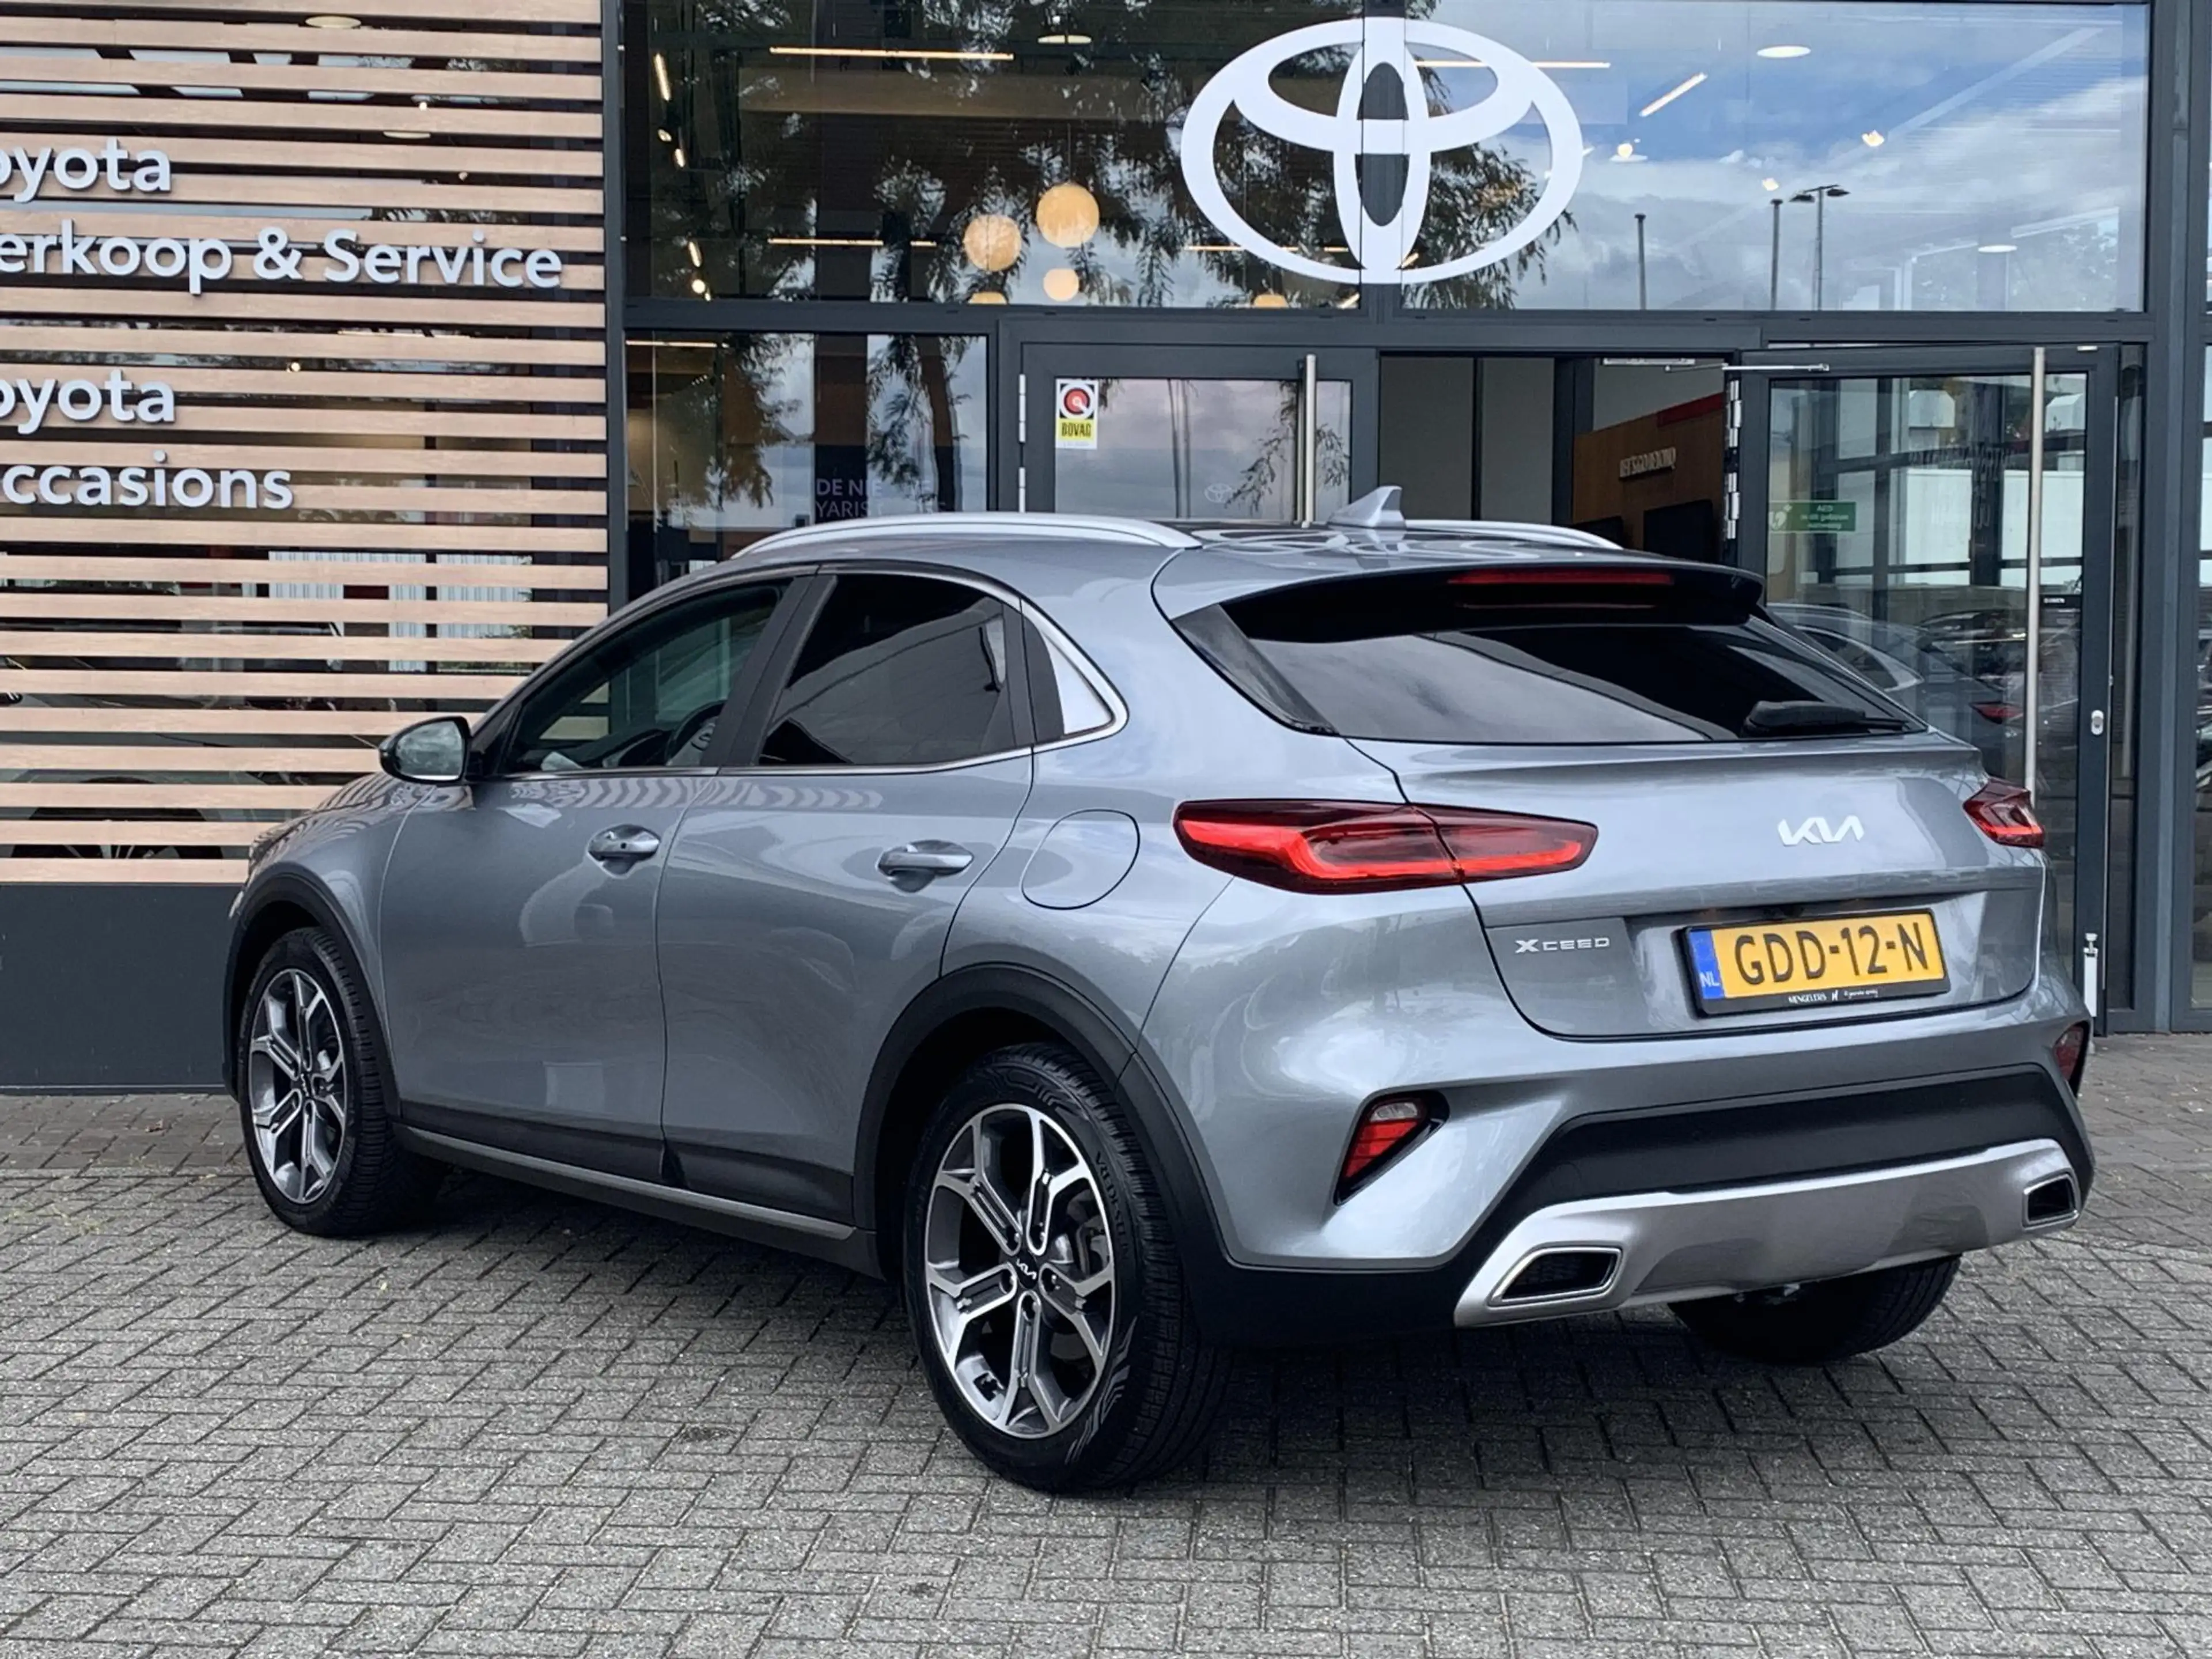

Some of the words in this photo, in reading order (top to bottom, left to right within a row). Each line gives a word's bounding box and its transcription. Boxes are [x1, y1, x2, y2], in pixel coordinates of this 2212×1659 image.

[0, 136, 171, 202] yota
[253, 226, 304, 281] &
[323, 229, 562, 288] Service
[1062, 422, 1091, 437] BOVAG
[2, 449, 293, 510] ccasions
[816, 478, 843, 497] DE
[1777, 815, 1865, 846] KIA
[1514, 937, 1610, 954] XCEED
[1734, 922, 1928, 985] GDD-12-N
[1699, 971, 1719, 987] NL
